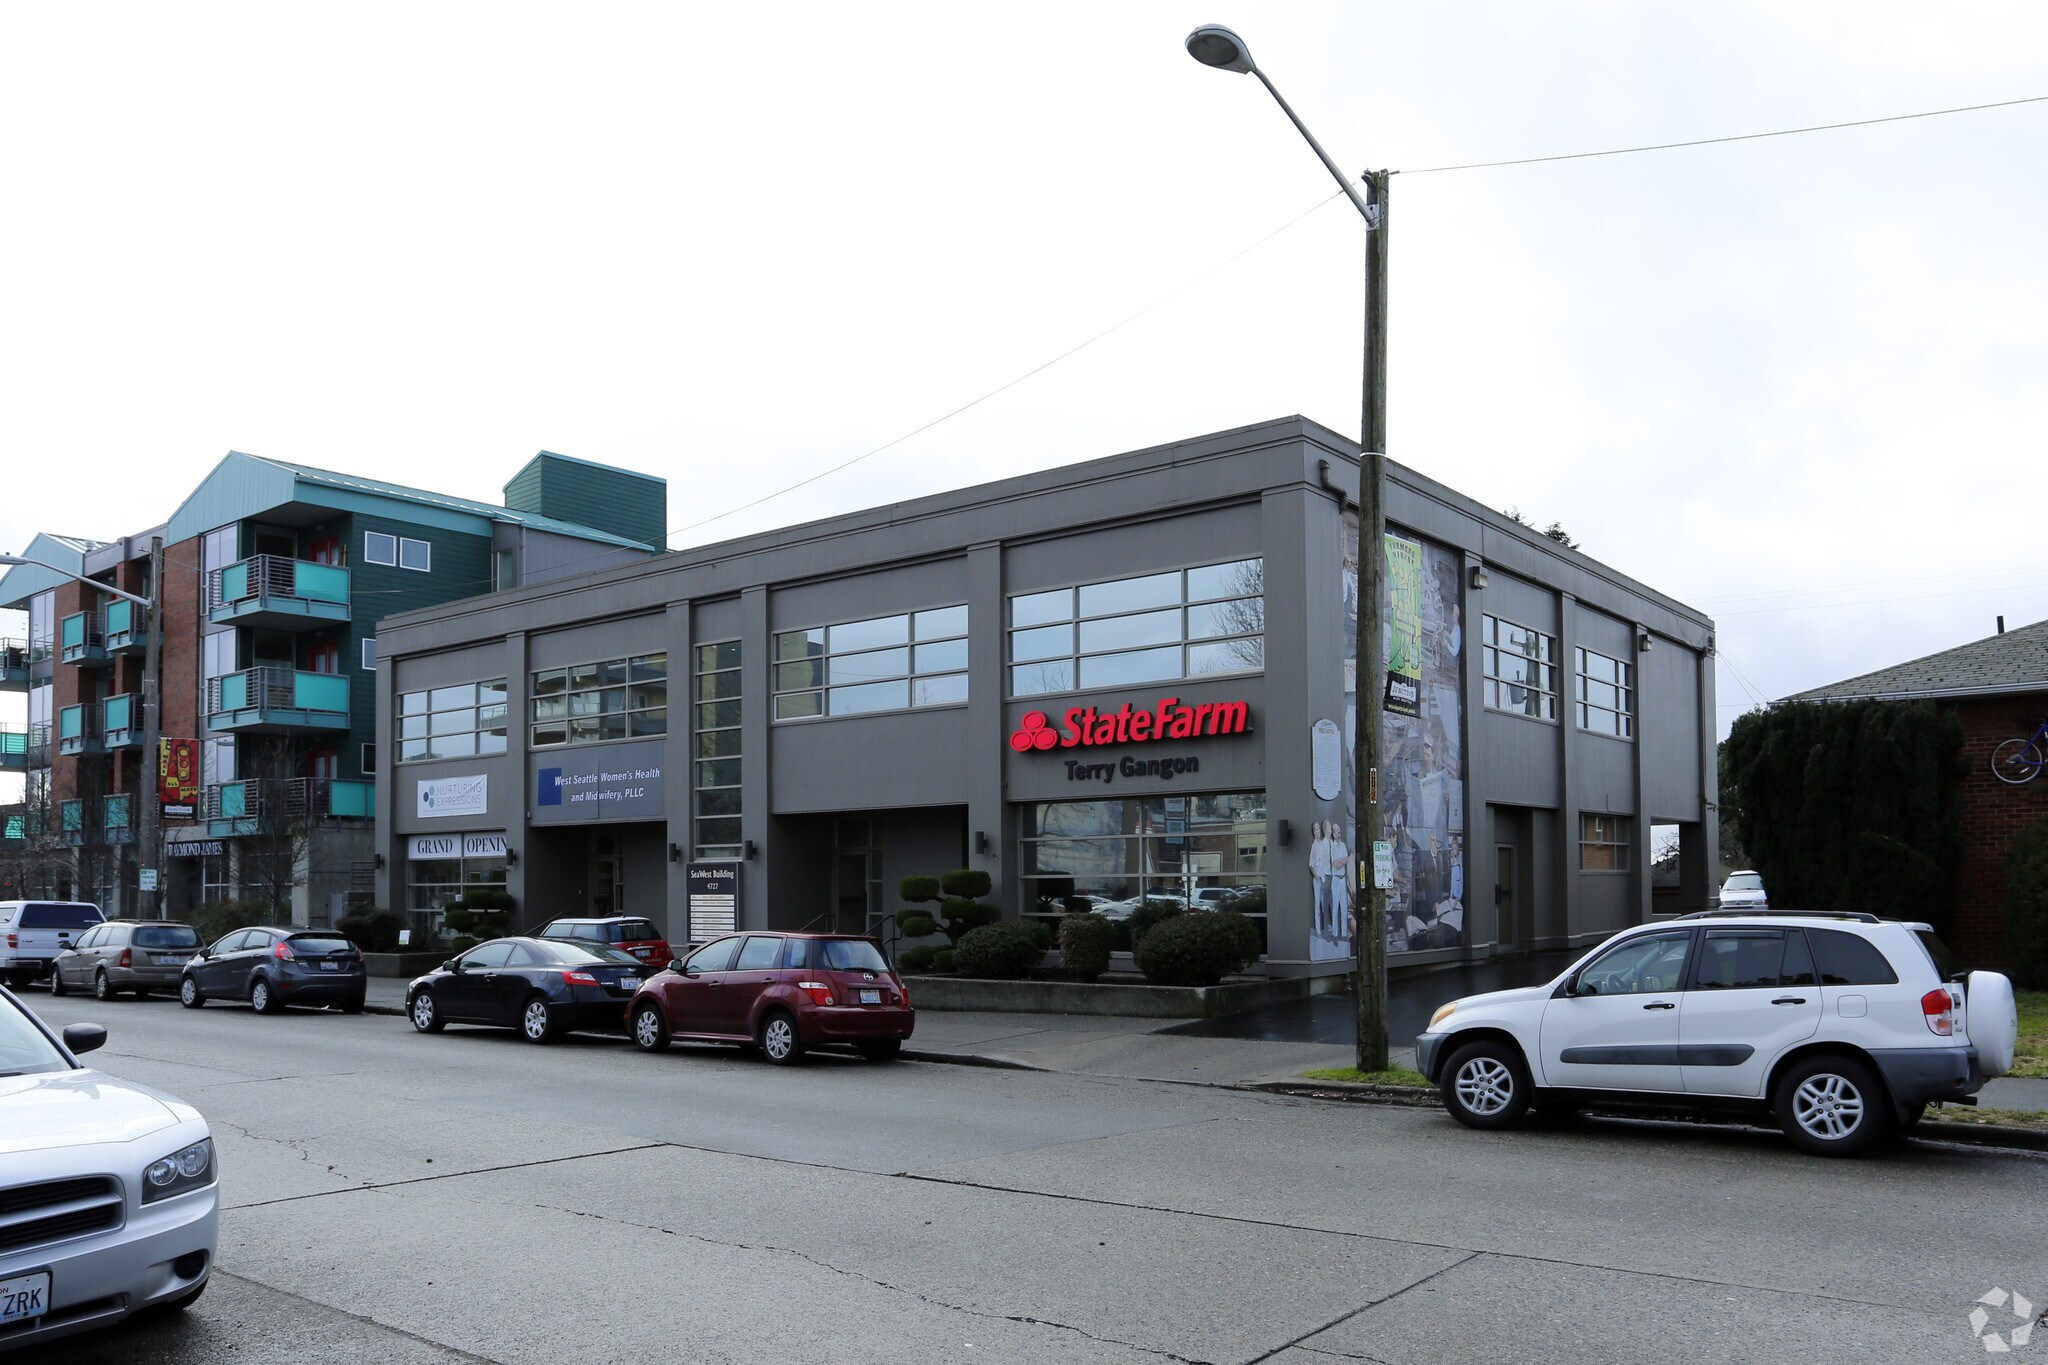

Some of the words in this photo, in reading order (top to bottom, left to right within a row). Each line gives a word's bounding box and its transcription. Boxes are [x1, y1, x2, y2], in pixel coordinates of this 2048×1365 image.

[554, 776, 571, 786] West
[573, 774, 598, 784] Seattle
[600, 770, 633, 782] Women's
[634, 768, 660, 779] Health
[1064, 760, 1116, 784] Terry
[1119, 755, 1199, 780] Gangon
[436, 782, 482, 795] NURTURING
[571, 792, 584, 802] and
[585, 789, 623, 801] Midwifery,
[624, 787, 645, 798] PLLC
[436, 794, 481, 807] EXPRESSIONS
[201, 842, 223, 855] JAMES
[417, 839, 453, 854] GRAND
[466, 837, 507, 853] OPENIN
[690, 870, 712, 879] SeaWest
[713, 869, 735, 880] Building
[3, 1288, 42, 1316] ZRK
